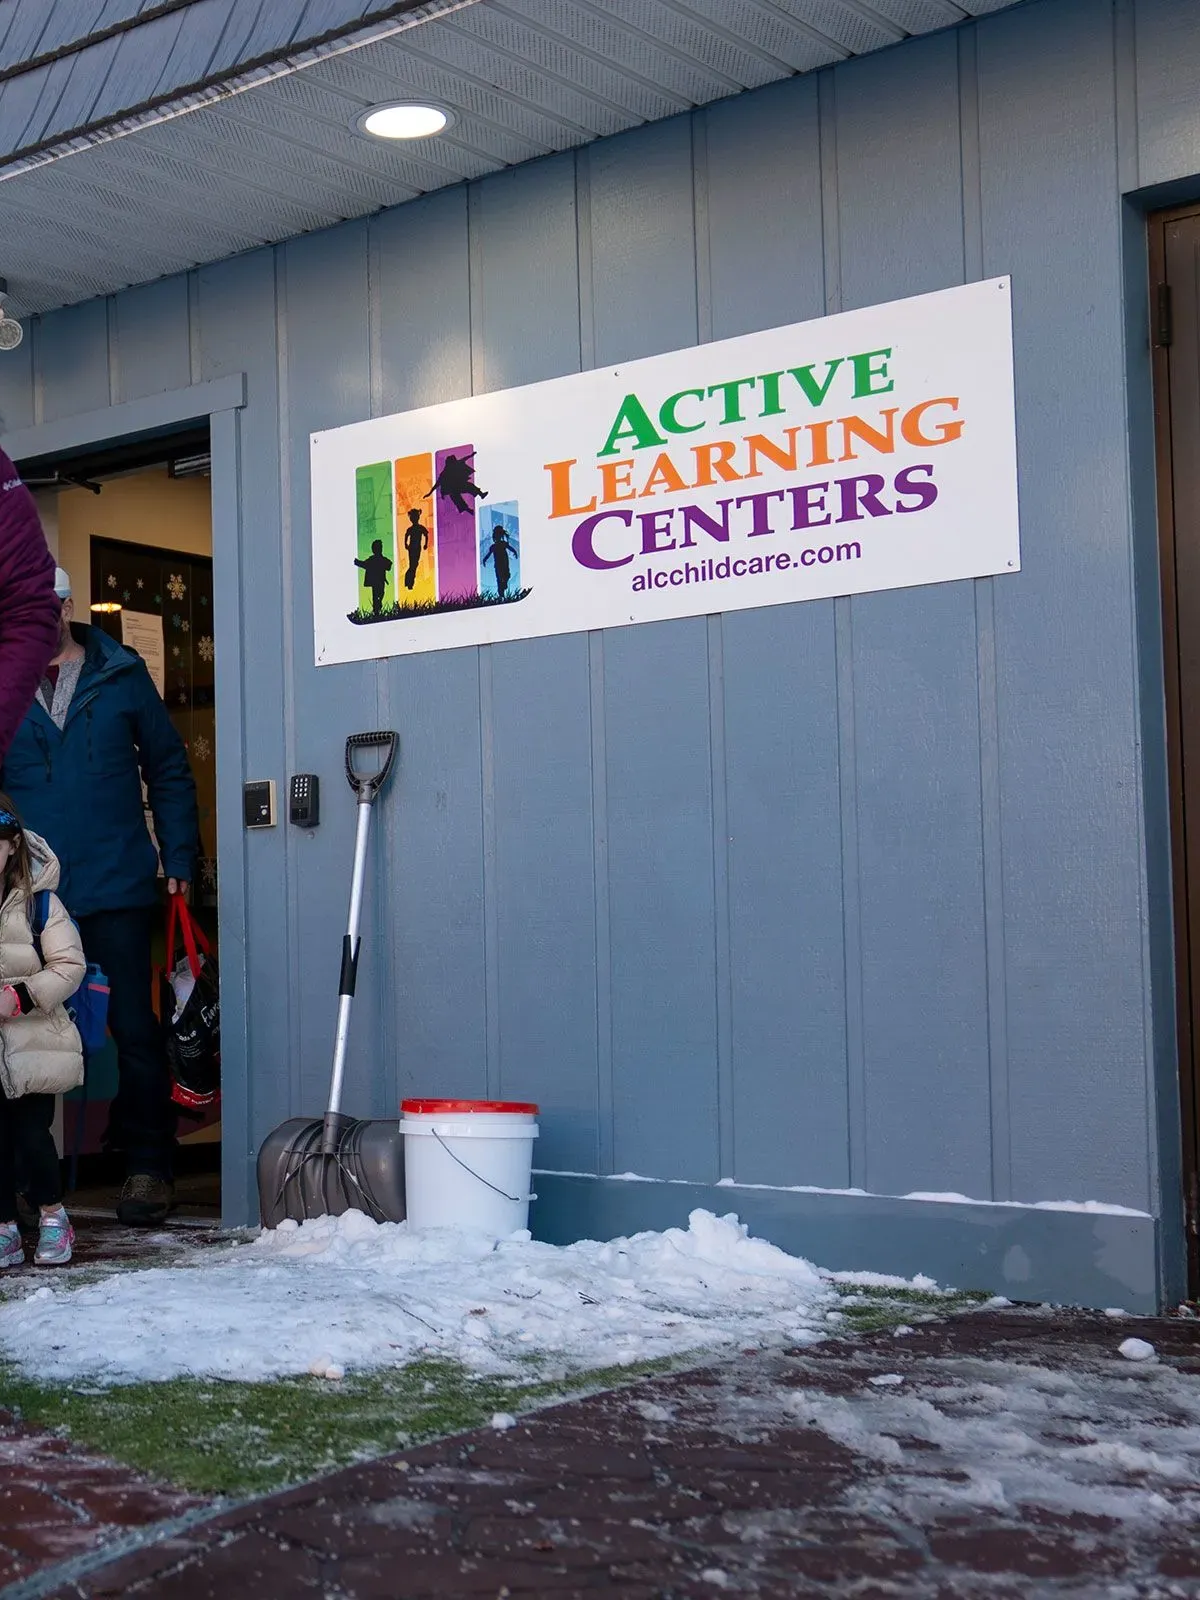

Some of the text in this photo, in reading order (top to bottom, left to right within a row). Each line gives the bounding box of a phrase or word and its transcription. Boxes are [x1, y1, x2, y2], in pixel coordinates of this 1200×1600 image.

[596, 348, 895, 457] ACTIVE
[543, 397, 965, 519] LEARNING
[571, 464, 938, 570] CENTERS
[631, 541, 861, 592] alcchildcare.com
